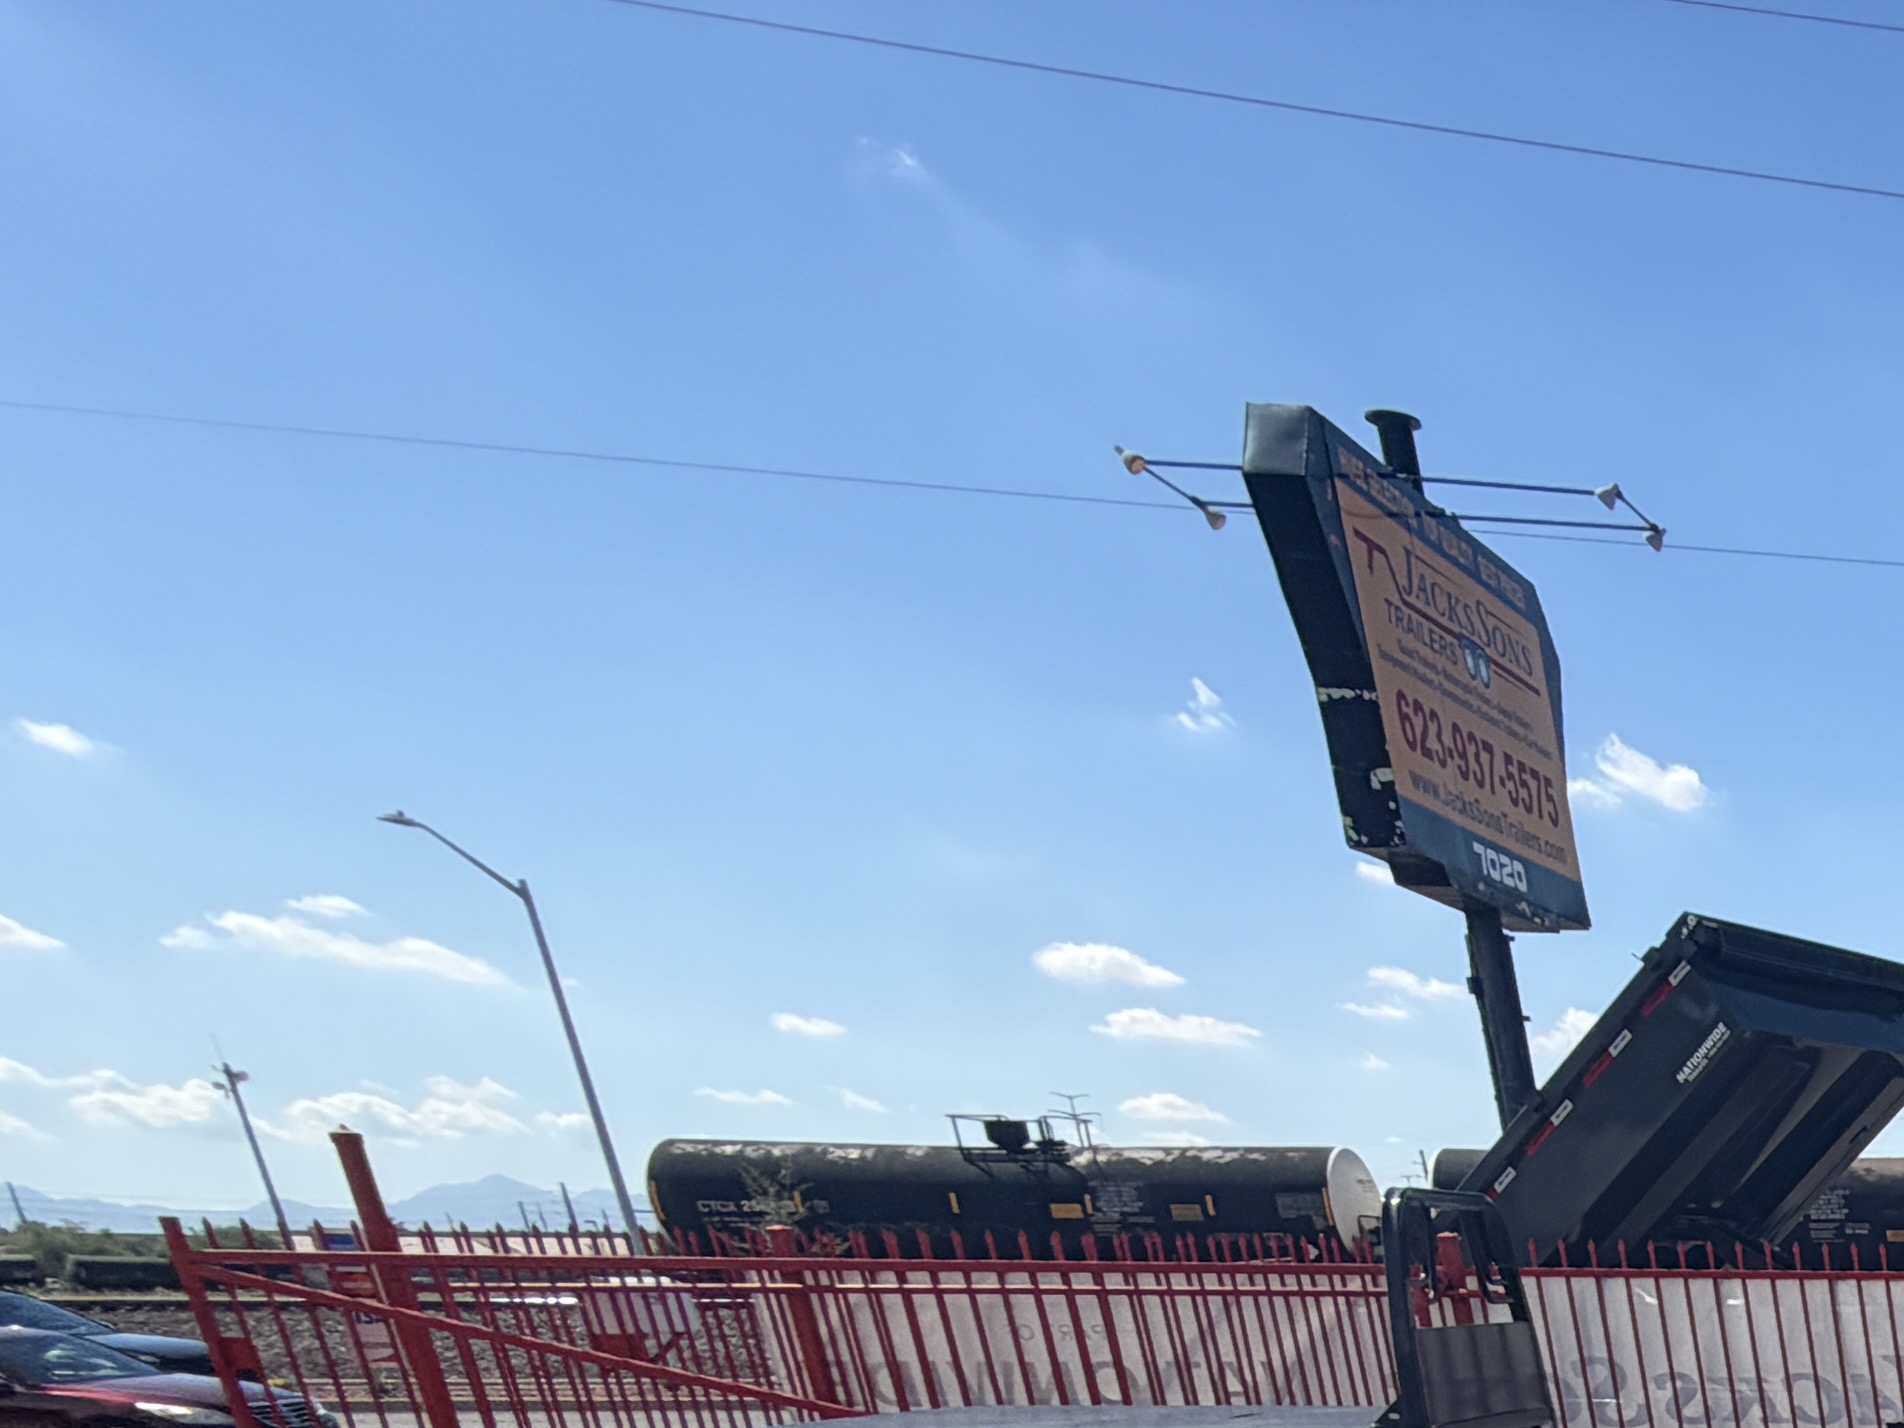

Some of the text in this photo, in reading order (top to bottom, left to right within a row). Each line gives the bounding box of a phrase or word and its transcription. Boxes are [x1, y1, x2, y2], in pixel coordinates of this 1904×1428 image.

[1383, 597, 1459, 666] TRAILERS
[1472, 840, 1528, 893] 7020
[1676, 1021, 1727, 1084] NATIONWIDE
